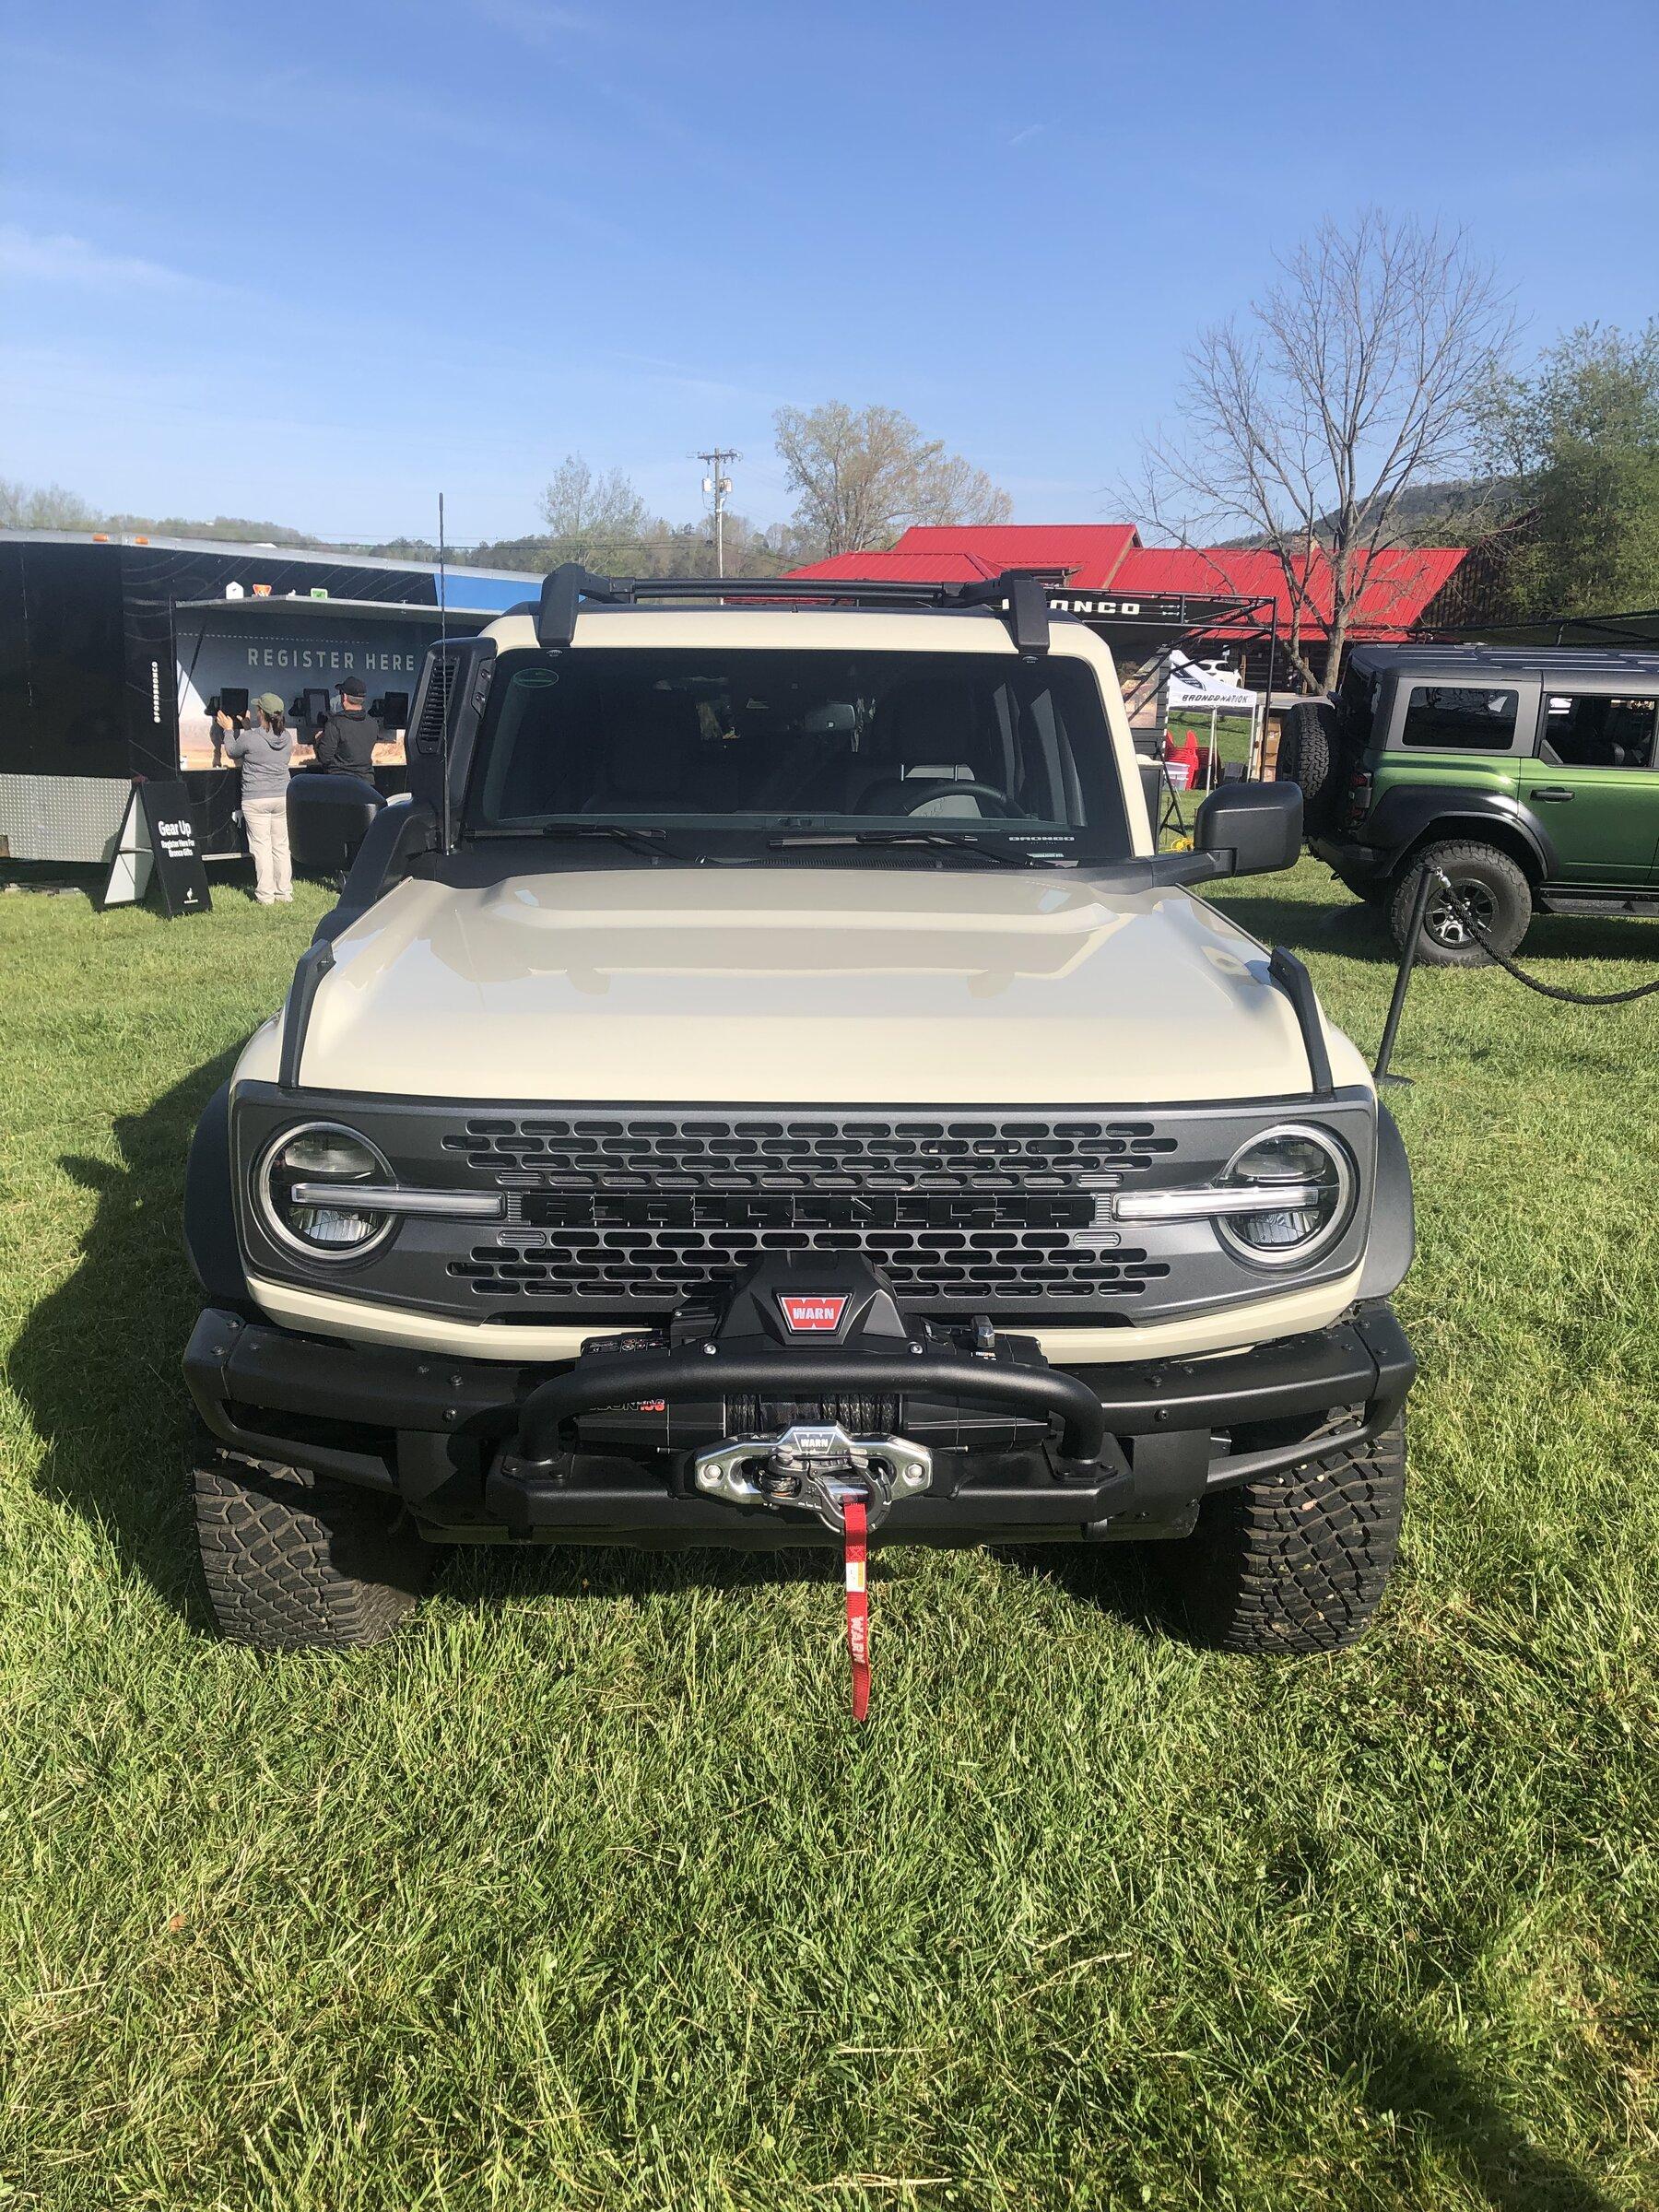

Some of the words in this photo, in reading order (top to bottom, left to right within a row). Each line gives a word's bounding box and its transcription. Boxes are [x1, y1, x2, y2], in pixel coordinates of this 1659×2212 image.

[1002, 598, 1140, 615] ONCO
[247, 648, 354, 669] REGISTER
[366, 653, 415, 671] HERE
[158, 820, 180, 837] Gear
[178, 819, 192, 838] Up
[793, 1307, 834, 1320] WARN
[800, 1438, 829, 1448] WARN
[851, 1616, 865, 1664] WARN
